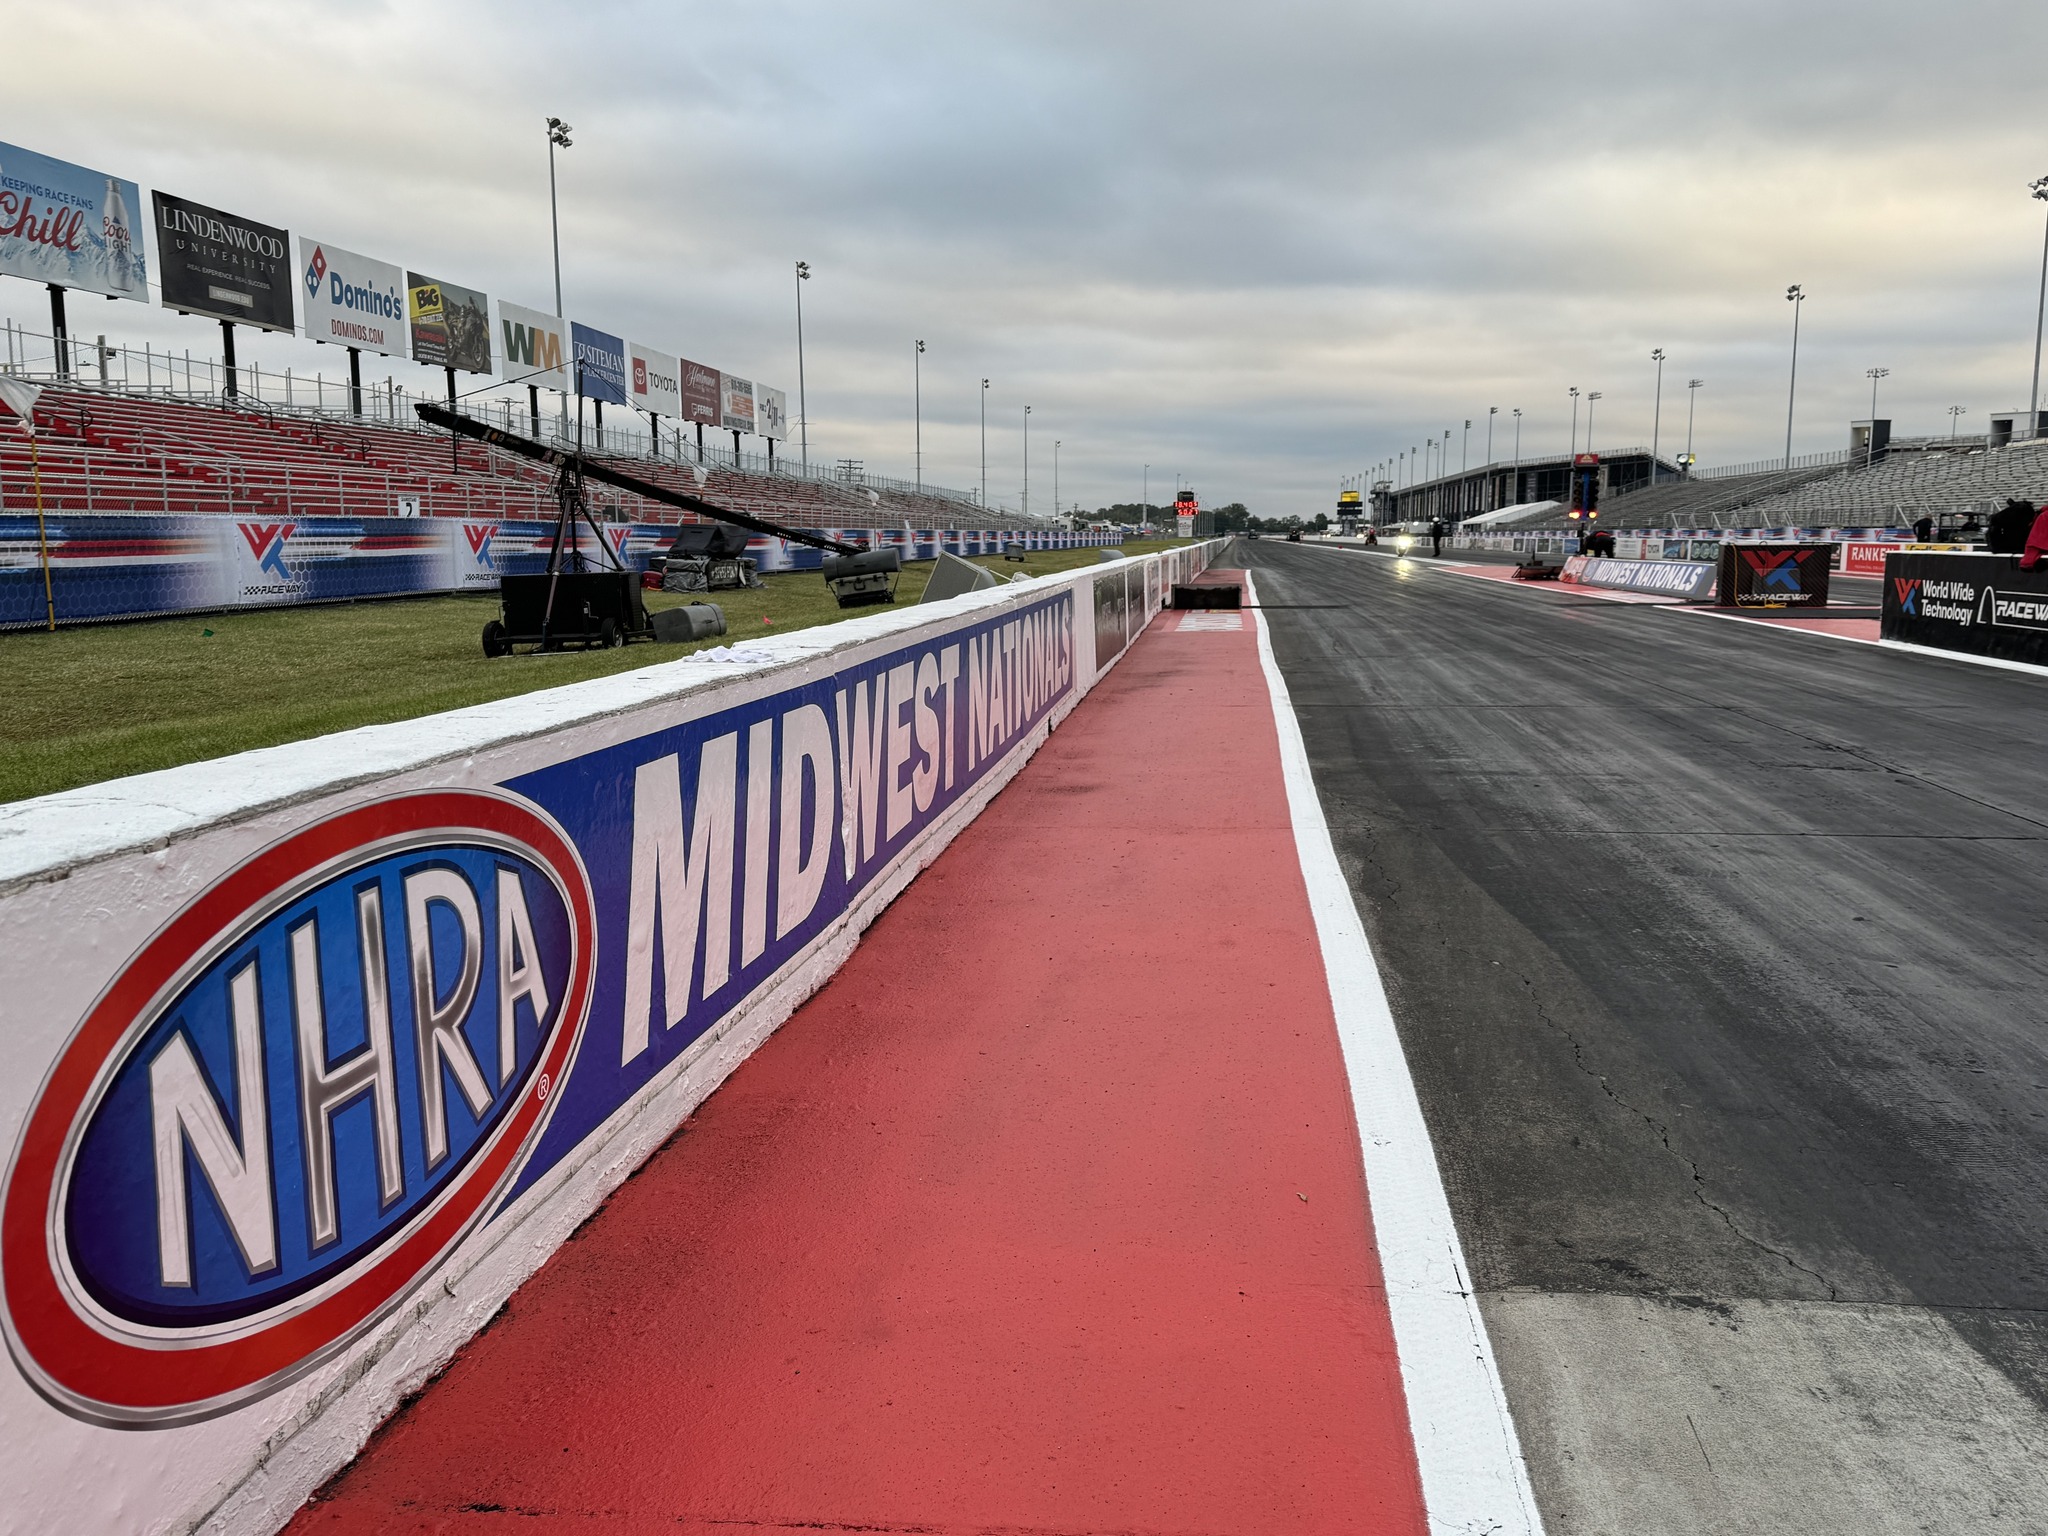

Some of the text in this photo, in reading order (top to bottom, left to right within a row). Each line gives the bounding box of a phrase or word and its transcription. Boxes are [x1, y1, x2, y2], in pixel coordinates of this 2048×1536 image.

[1, 175, 94, 210] KEEPING RACE FANS
[0, 191, 84, 251] Chill
[161, 205, 284, 259] LINDENWOOD
[176, 239, 275, 274] UNIVERSITY
[330, 271, 402, 320] Domino's
[331, 319, 385, 345] DOMINOS.COM
[502, 319, 564, 374] WM
[586, 345, 625, 373] SITEMAN
[649, 372, 679, 395] TOYOTA
[260, 584, 302, 595] RACEWAY
[1591, 561, 1640, 585] MIDWEST
[1632, 563, 1703, 591] NATIONALS
[1922, 579, 1975, 602] World Wide
[1760, 593, 1812, 601] RACEWAY
[1996, 600, 2048, 621] RACEW
[1921, 599, 1973, 626] Technology
[621, 597, 1070, 1068] MIDWEST NATIONALS
[148, 867, 550, 1288] NHRA
